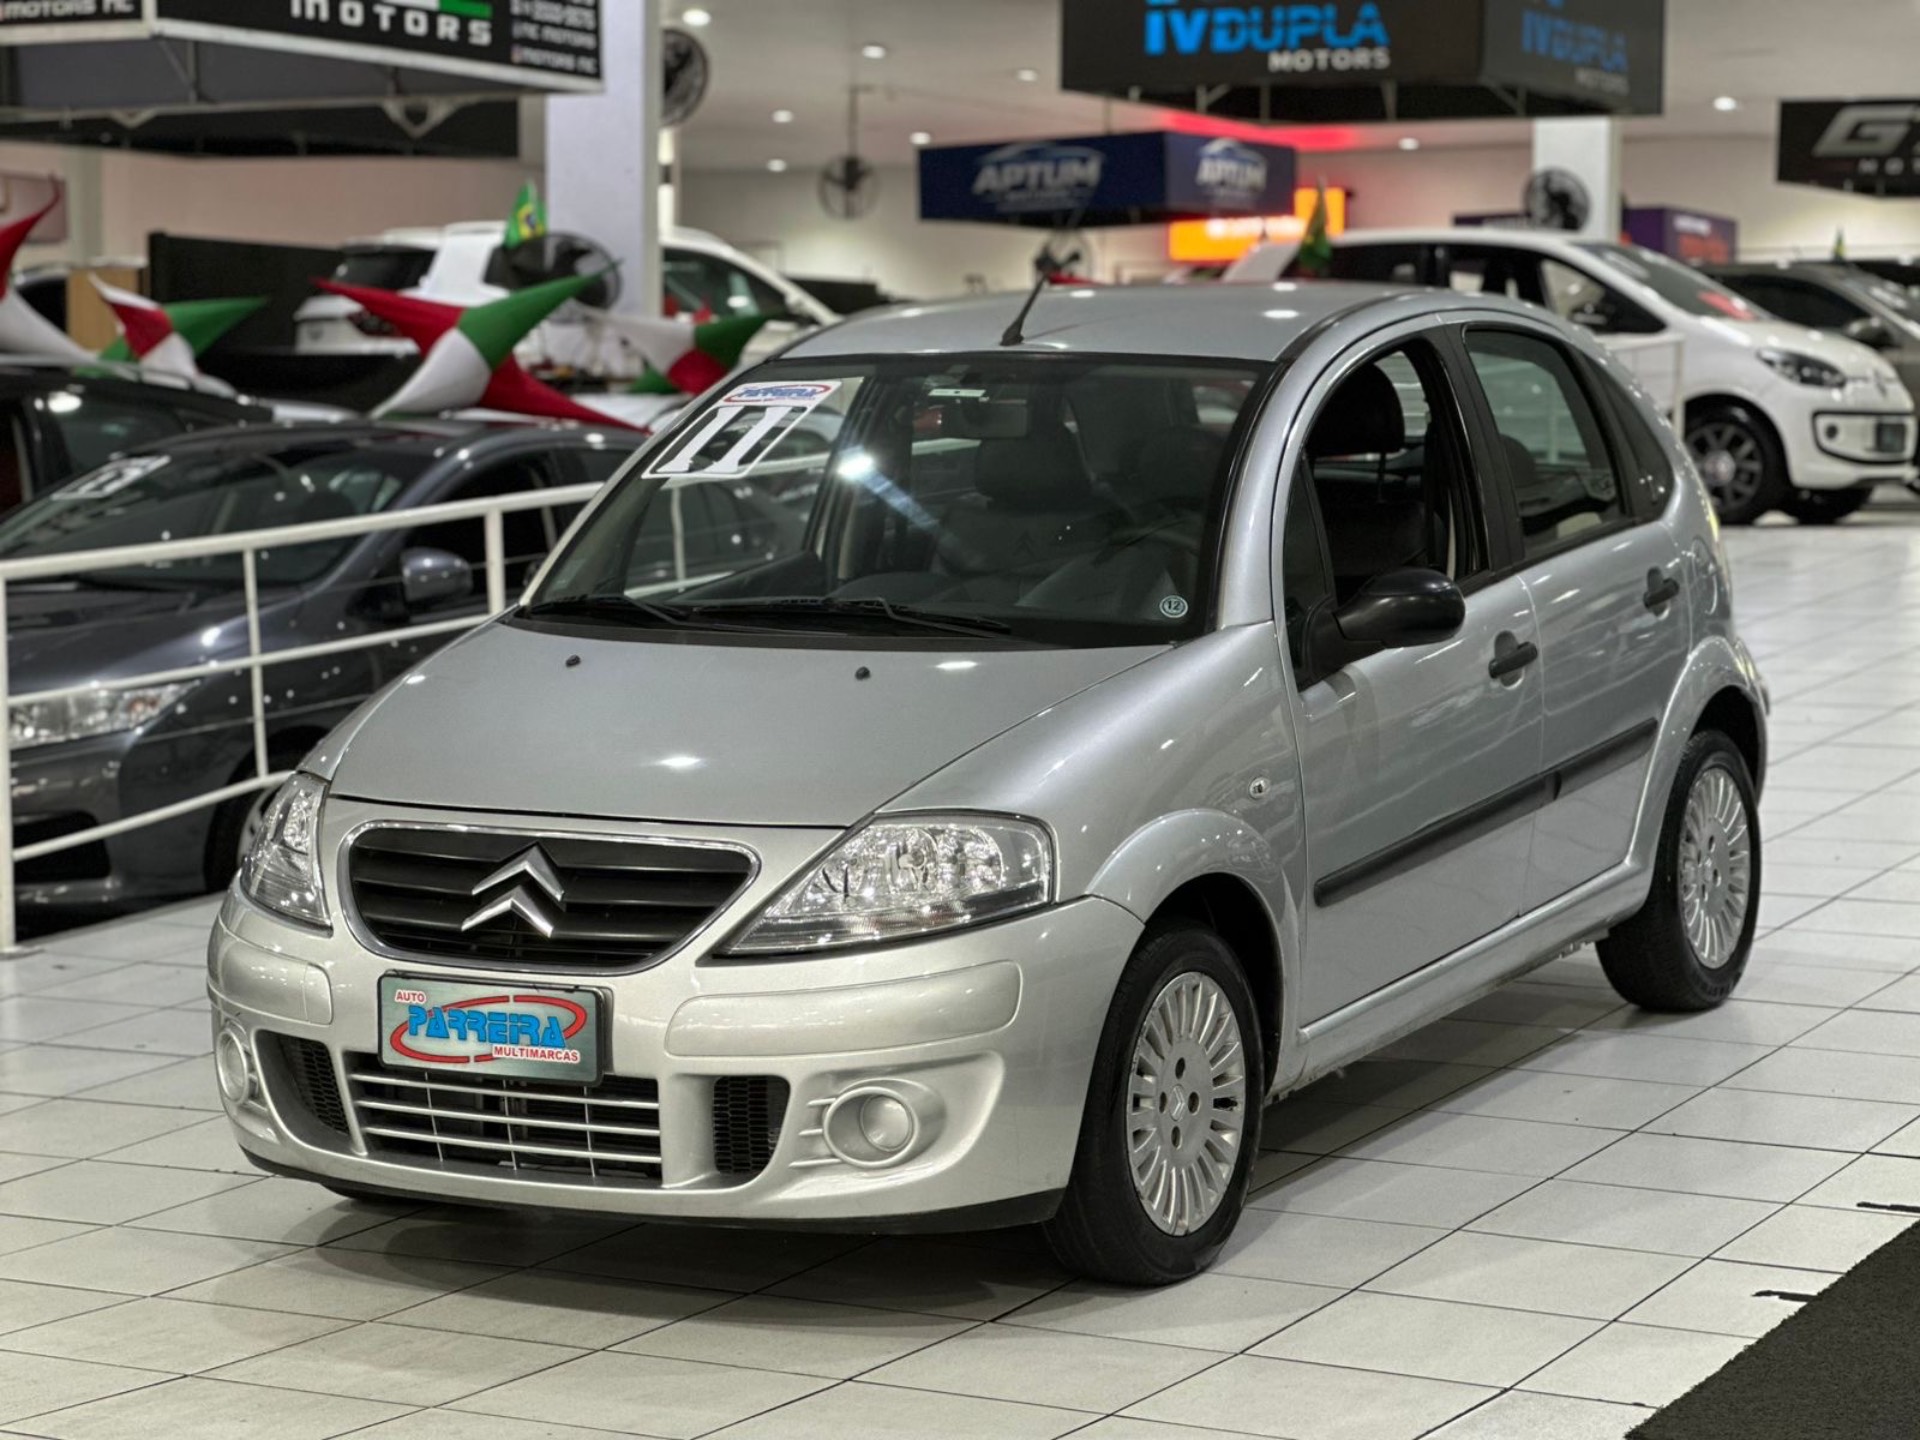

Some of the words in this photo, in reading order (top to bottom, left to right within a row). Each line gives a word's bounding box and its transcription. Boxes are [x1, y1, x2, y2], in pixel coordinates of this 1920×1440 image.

[290, 0, 492, 46] MOTORS
[1268, 46, 1391, 72] MOTORS
[1811, 104, 1920, 157] G
[971, 154, 1104, 195] APTUM
[1168, 600, 1181, 610] 12
[396, 991, 426, 1003] AUTO
[408, 1005, 566, 1048] PARREIRA
[494, 1046, 579, 1062] MULTIMARCAS
